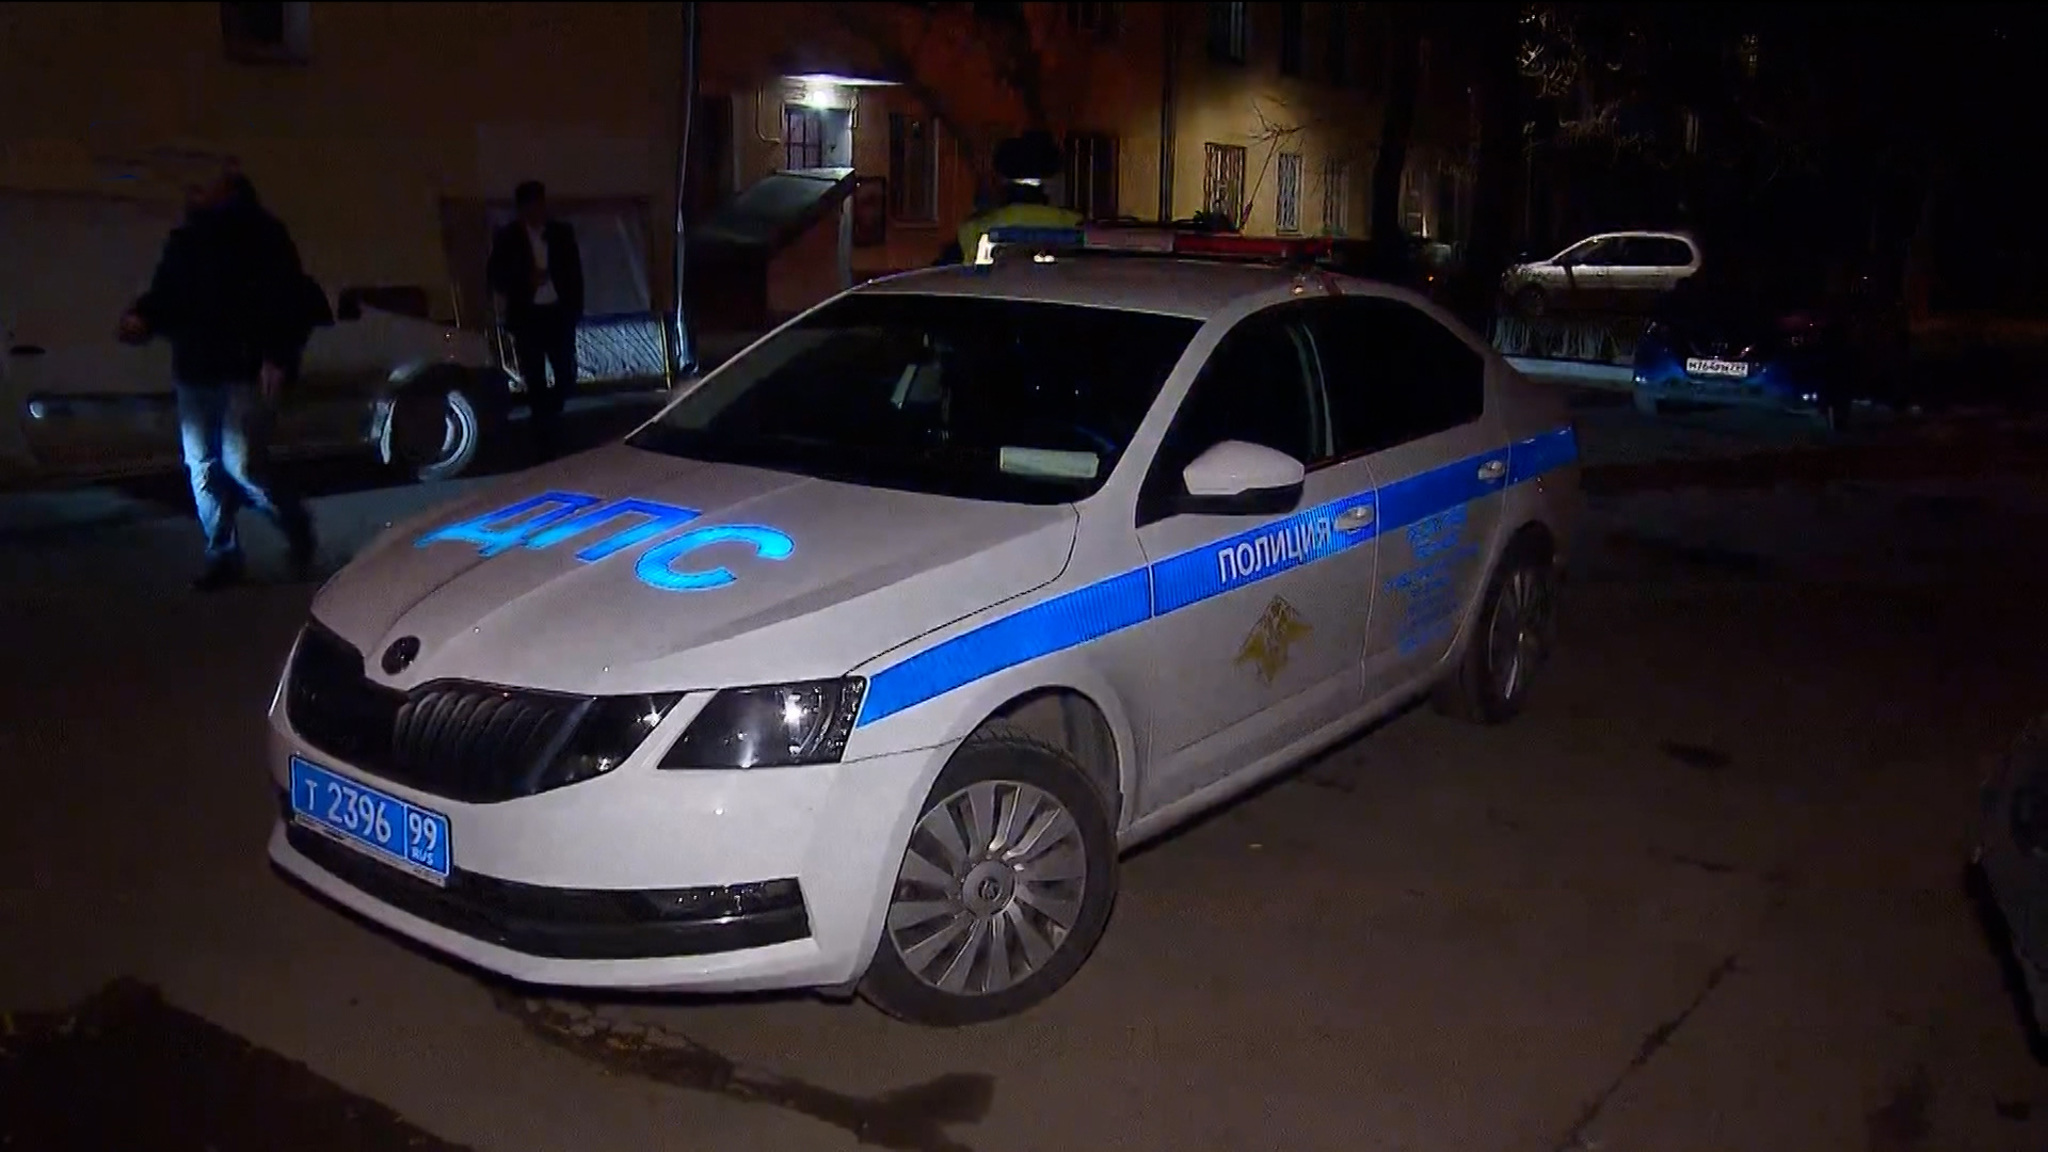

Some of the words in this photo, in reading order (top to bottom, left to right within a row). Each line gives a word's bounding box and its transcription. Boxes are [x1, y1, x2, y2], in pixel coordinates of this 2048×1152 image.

[412, 489, 795, 592] ДПС
[1218, 516, 1331, 584] ПОЛИЦИЯ
[327, 781, 392, 844] 2396
[408, 811, 438, 851] 99
[411, 847, 434, 867] RUS
